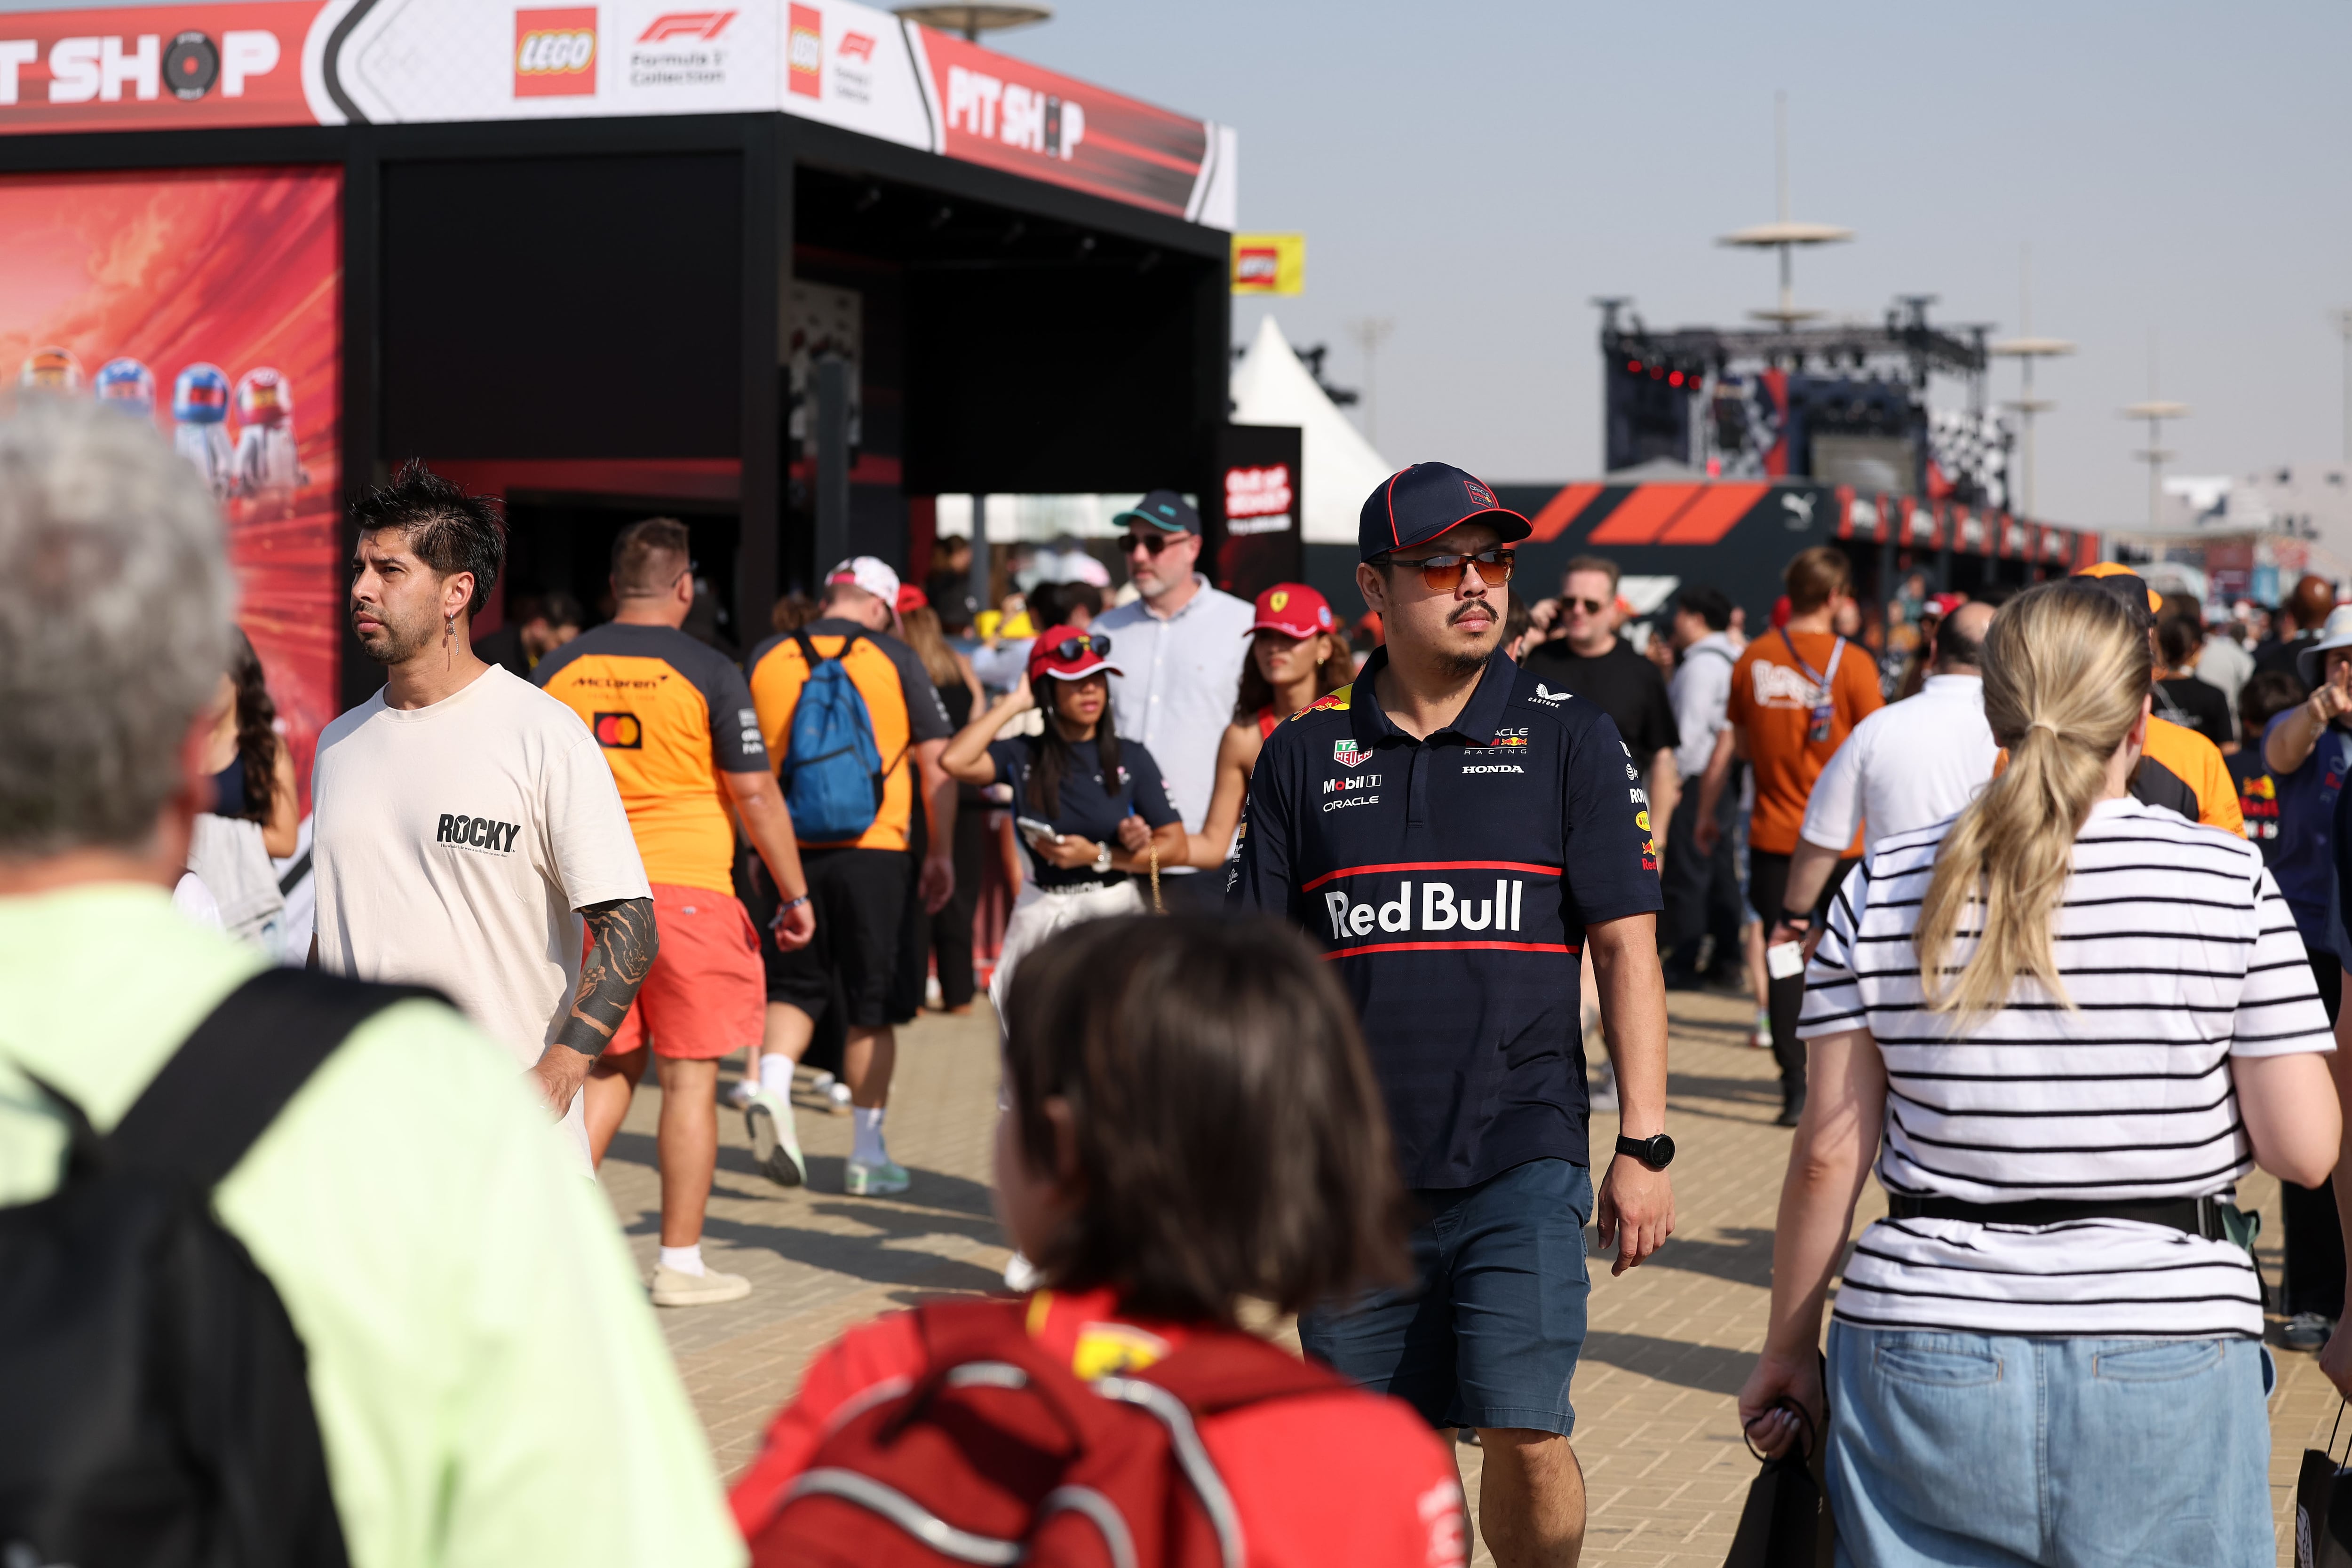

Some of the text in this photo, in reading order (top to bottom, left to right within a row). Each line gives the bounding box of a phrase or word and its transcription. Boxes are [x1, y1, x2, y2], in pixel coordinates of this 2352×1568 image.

[518, 32, 595, 72] LEGO
[631, 51, 707, 66] Formula
[48, 29, 281, 104] SHOP
[630, 70, 726, 87] Collection
[947, 66, 1002, 138] PIT
[571, 678, 657, 689] McLaren
[1528, 697, 1560, 708] CASTORE
[1495, 728, 1529, 736] ACLE
[1339, 742, 1359, 751] TA
[1336, 751, 1370, 765] HEUER
[1462, 765, 1525, 774] HONDA
[1323, 776, 1364, 794] Mobil
[1323, 795, 1379, 812] ORACLE
[437, 814, 521, 853] ROCKY
[1325, 880, 1523, 939] Red Bull
